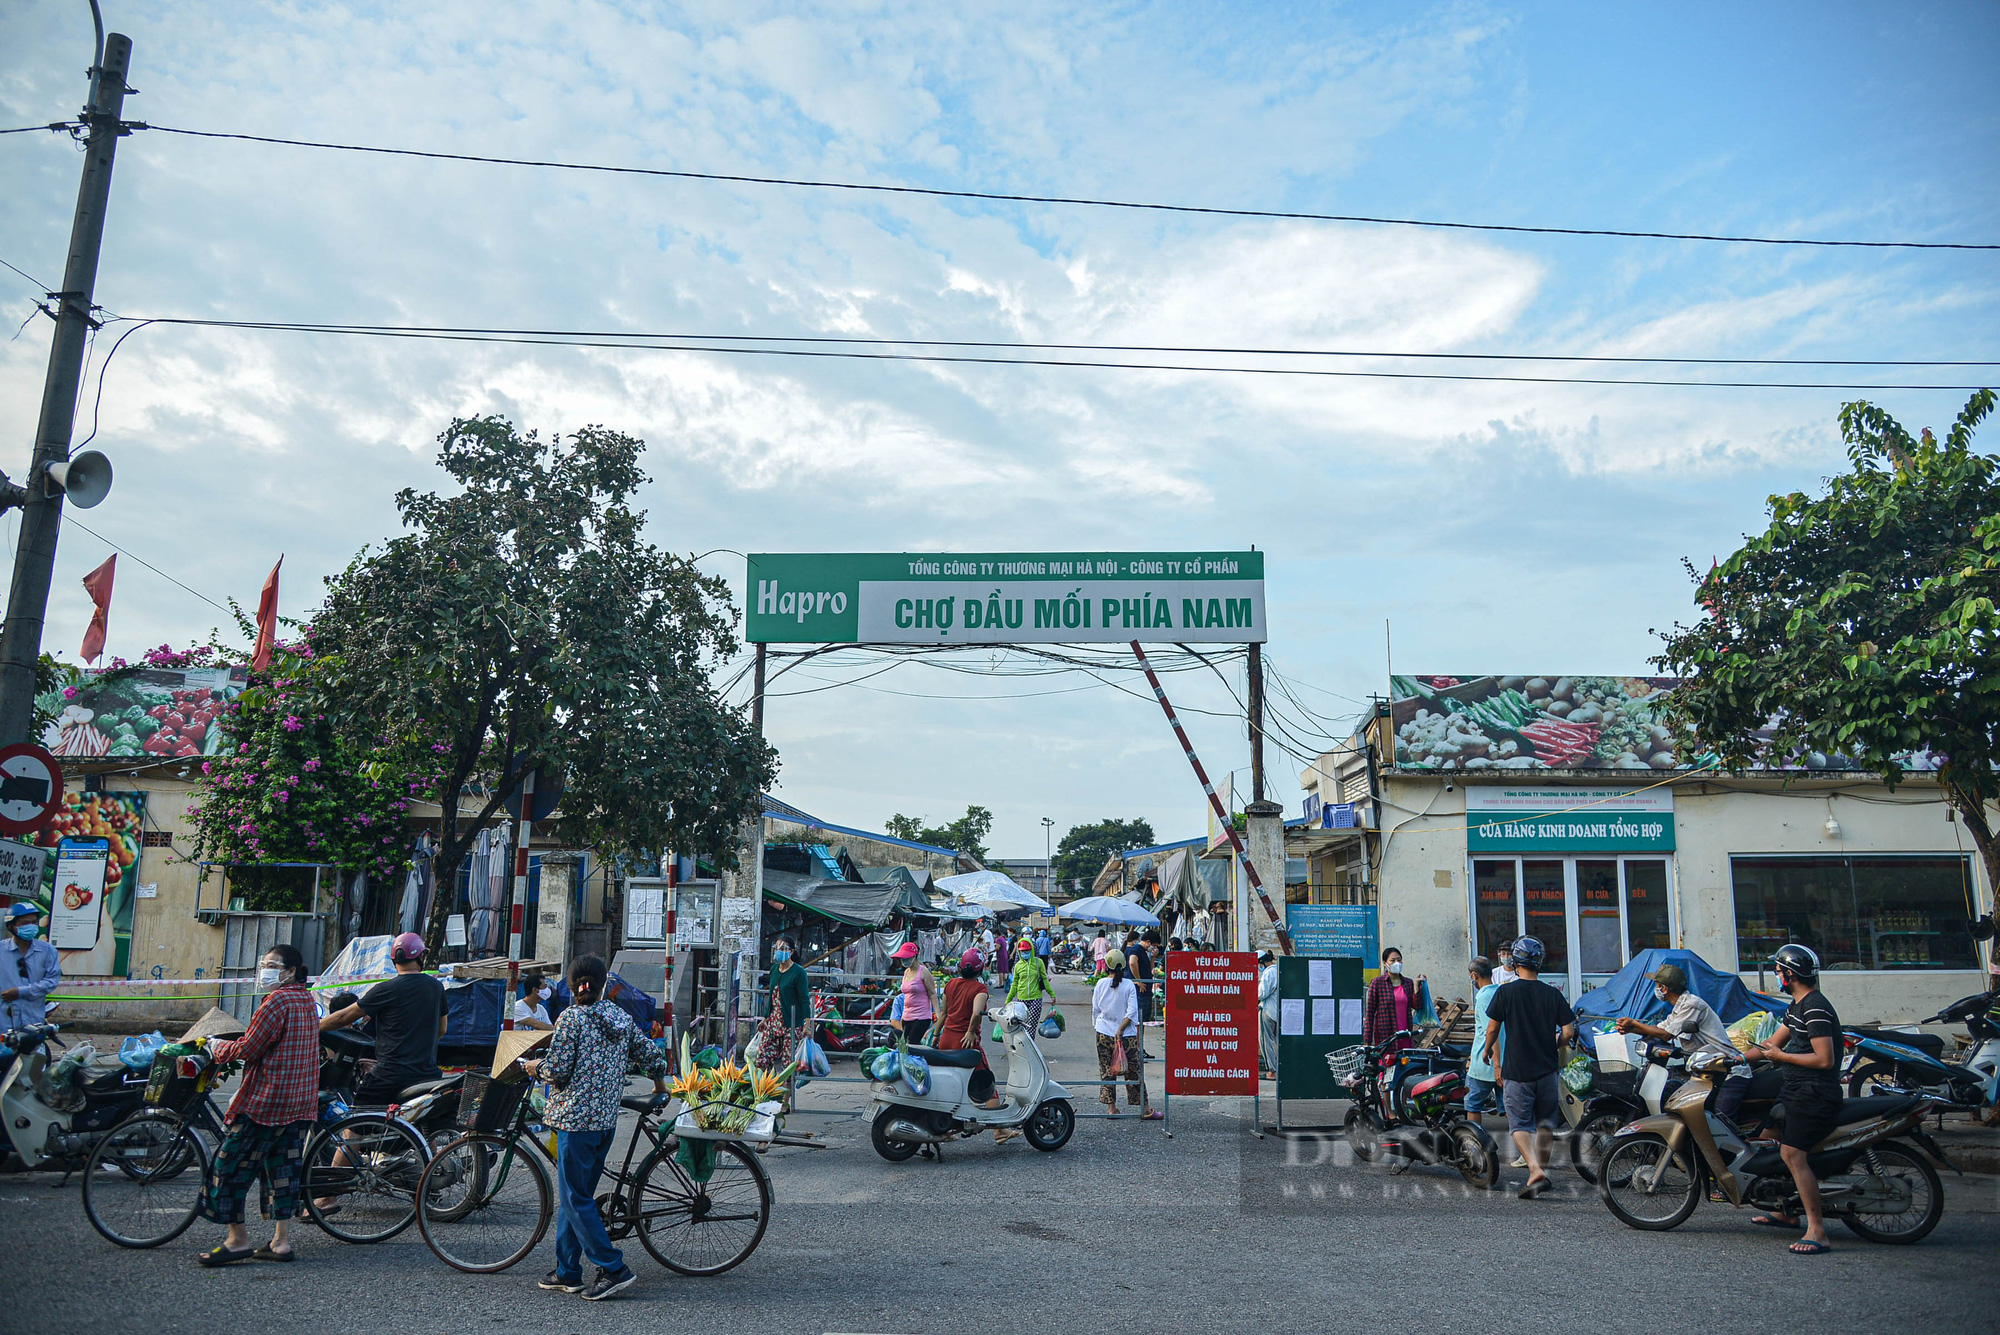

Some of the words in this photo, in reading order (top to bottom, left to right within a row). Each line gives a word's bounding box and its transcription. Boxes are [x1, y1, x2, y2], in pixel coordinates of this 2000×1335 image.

[908, 558, 940, 575] TỔNG
[944, 560, 976, 575] CÔNG
[980, 562, 994, 574] TY
[998, 562, 1046, 575] THƯƠNG
[1050, 562, 1072, 578] MẠI
[1076, 560, 1093, 574] HÀ
[1097, 559, 1118, 577] NỘI
[1130, 559, 1163, 574] CÔNG
[1167, 561, 1181, 574] TY
[1185, 556, 1202, 574] CỔ
[1205, 556, 1238, 574] PHẦN
[757, 580, 848, 624] Hapro
[894, 596, 955, 636] CHỢ
[963, 588, 1023, 629] ĐẦU
[1034, 588, 1091, 628] MỐI
[1102, 592, 1172, 628] PHÍA
[1182, 598, 1252, 628] NAM
[1479, 818, 1502, 838] CỬA
[1505, 821, 1536, 838] HÀNG
[1538, 824, 1566, 838] KINH
[1568, 824, 1607, 838] DOANH
[1608, 817, 1639, 838] TỔNG
[1641, 822, 1664, 840] HỢP
[1195, 956, 1210, 966] YÊU
[1171, 969, 1187, 980] CÁC
[1190, 970, 1201, 981] HỘ
[1203, 971, 1223, 980] KINH
[1226, 972, 1253, 980] DOANH
[1184, 983, 1195, 993] VÀ
[1197, 984, 1220, 994] NHÂN
[1223, 984, 1240, 994] DÂN
[1193, 1010, 1212, 1022] PHẢI
[1211, 1027, 1238, 1036] TRANG
[1186, 1041, 1200, 1049] KHI
[1202, 1039, 1218, 1050] VÀO
[1221, 1041, 1238, 1052] CHỢ
[1206, 1053, 1218, 1064] VÀ
[1174, 1067, 1189, 1077] GIỮ
[1190, 1066, 1224, 1078] KHOẢNG
[1227, 1068, 1249, 1078] CÁCH
